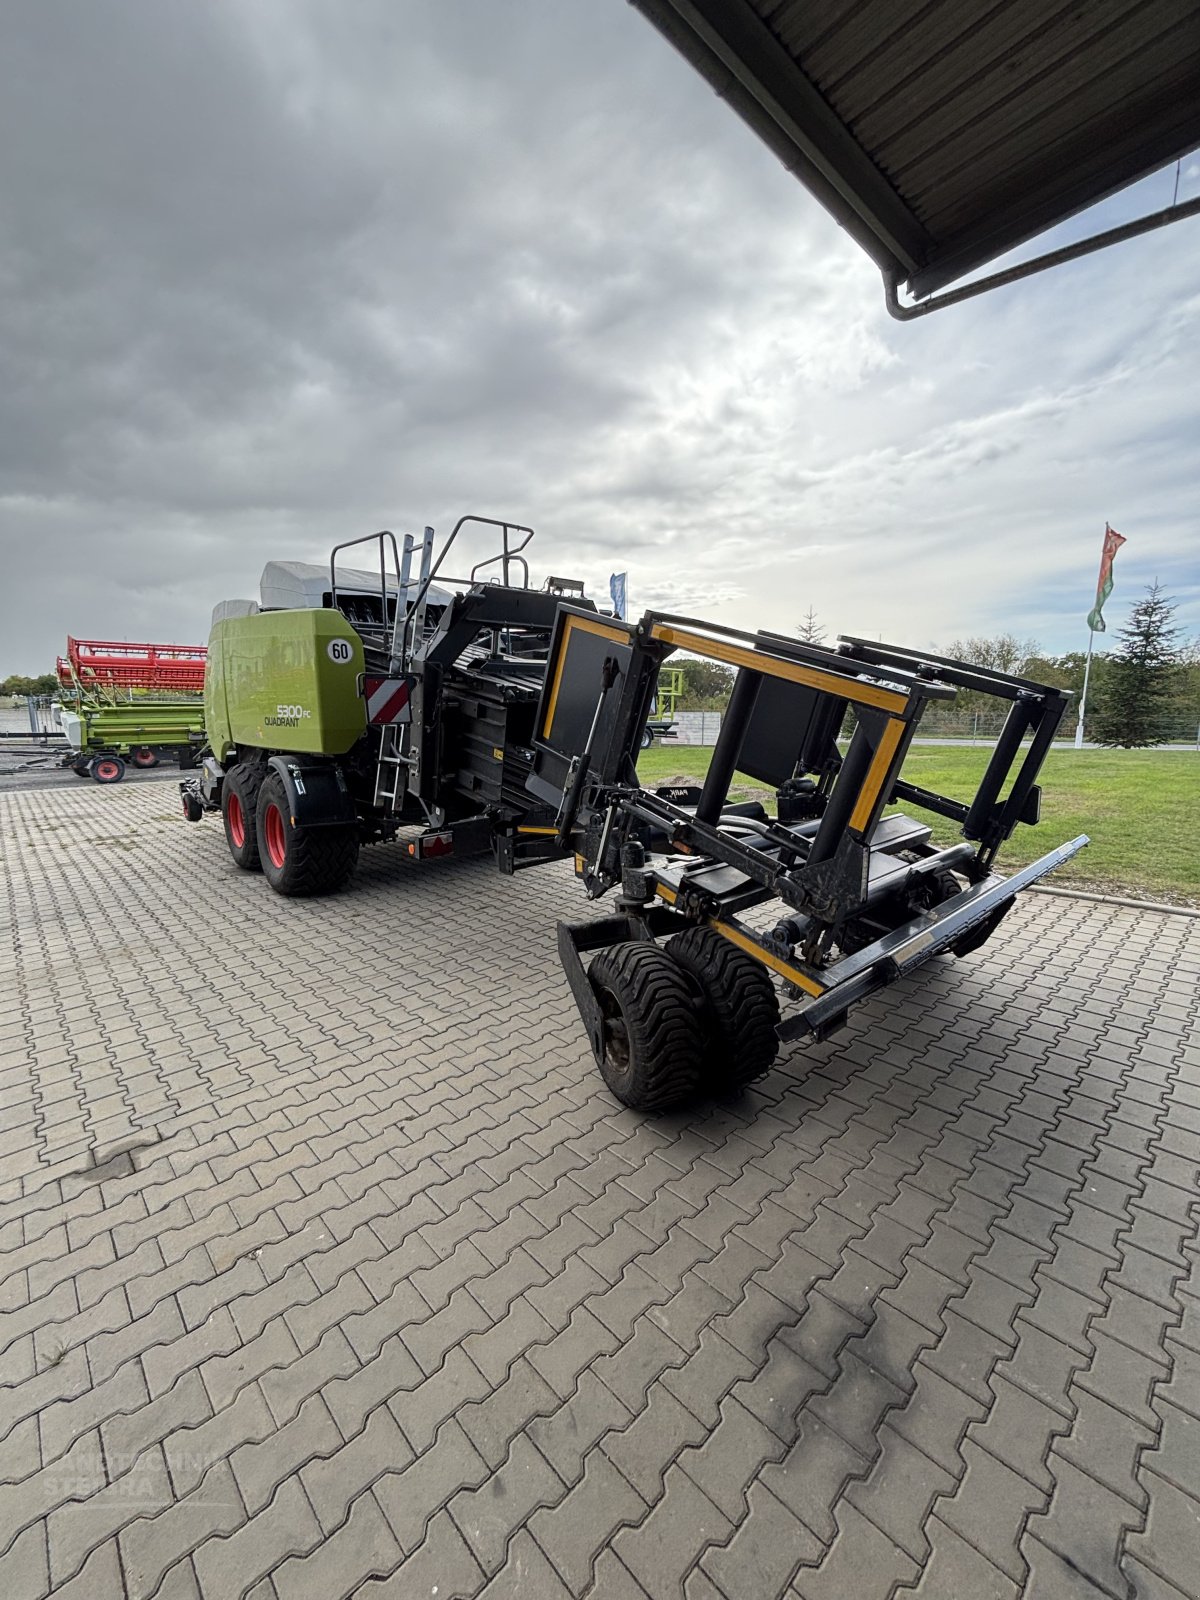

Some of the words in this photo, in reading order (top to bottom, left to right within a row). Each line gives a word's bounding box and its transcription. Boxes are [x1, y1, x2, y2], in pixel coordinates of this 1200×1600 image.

[332, 643, 348, 660] 60
[277, 705, 302, 718] 5300
[264, 717, 300, 728] QUADRANT
